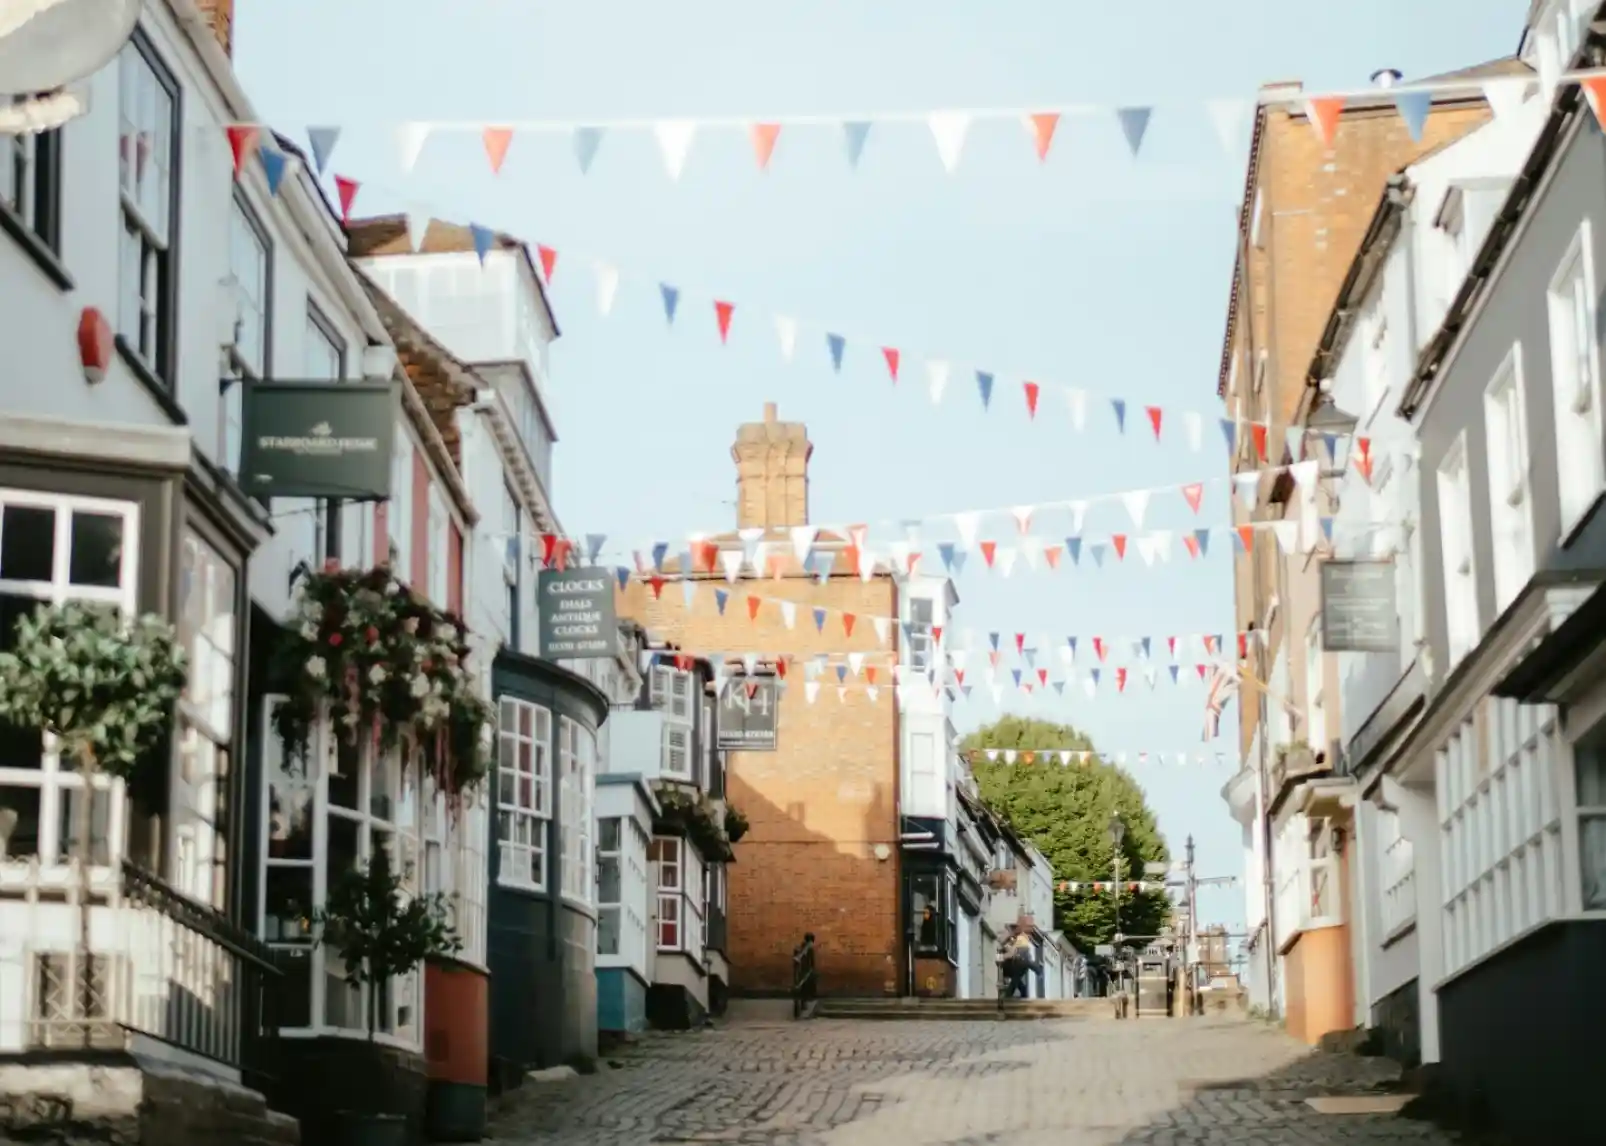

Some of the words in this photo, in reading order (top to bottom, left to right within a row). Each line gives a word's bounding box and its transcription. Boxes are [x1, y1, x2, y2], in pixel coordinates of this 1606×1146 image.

[548, 580, 604, 594] CLOCKS
[551, 611, 601, 622] ANTIQUE
[554, 625, 598, 635] CLOCKS
